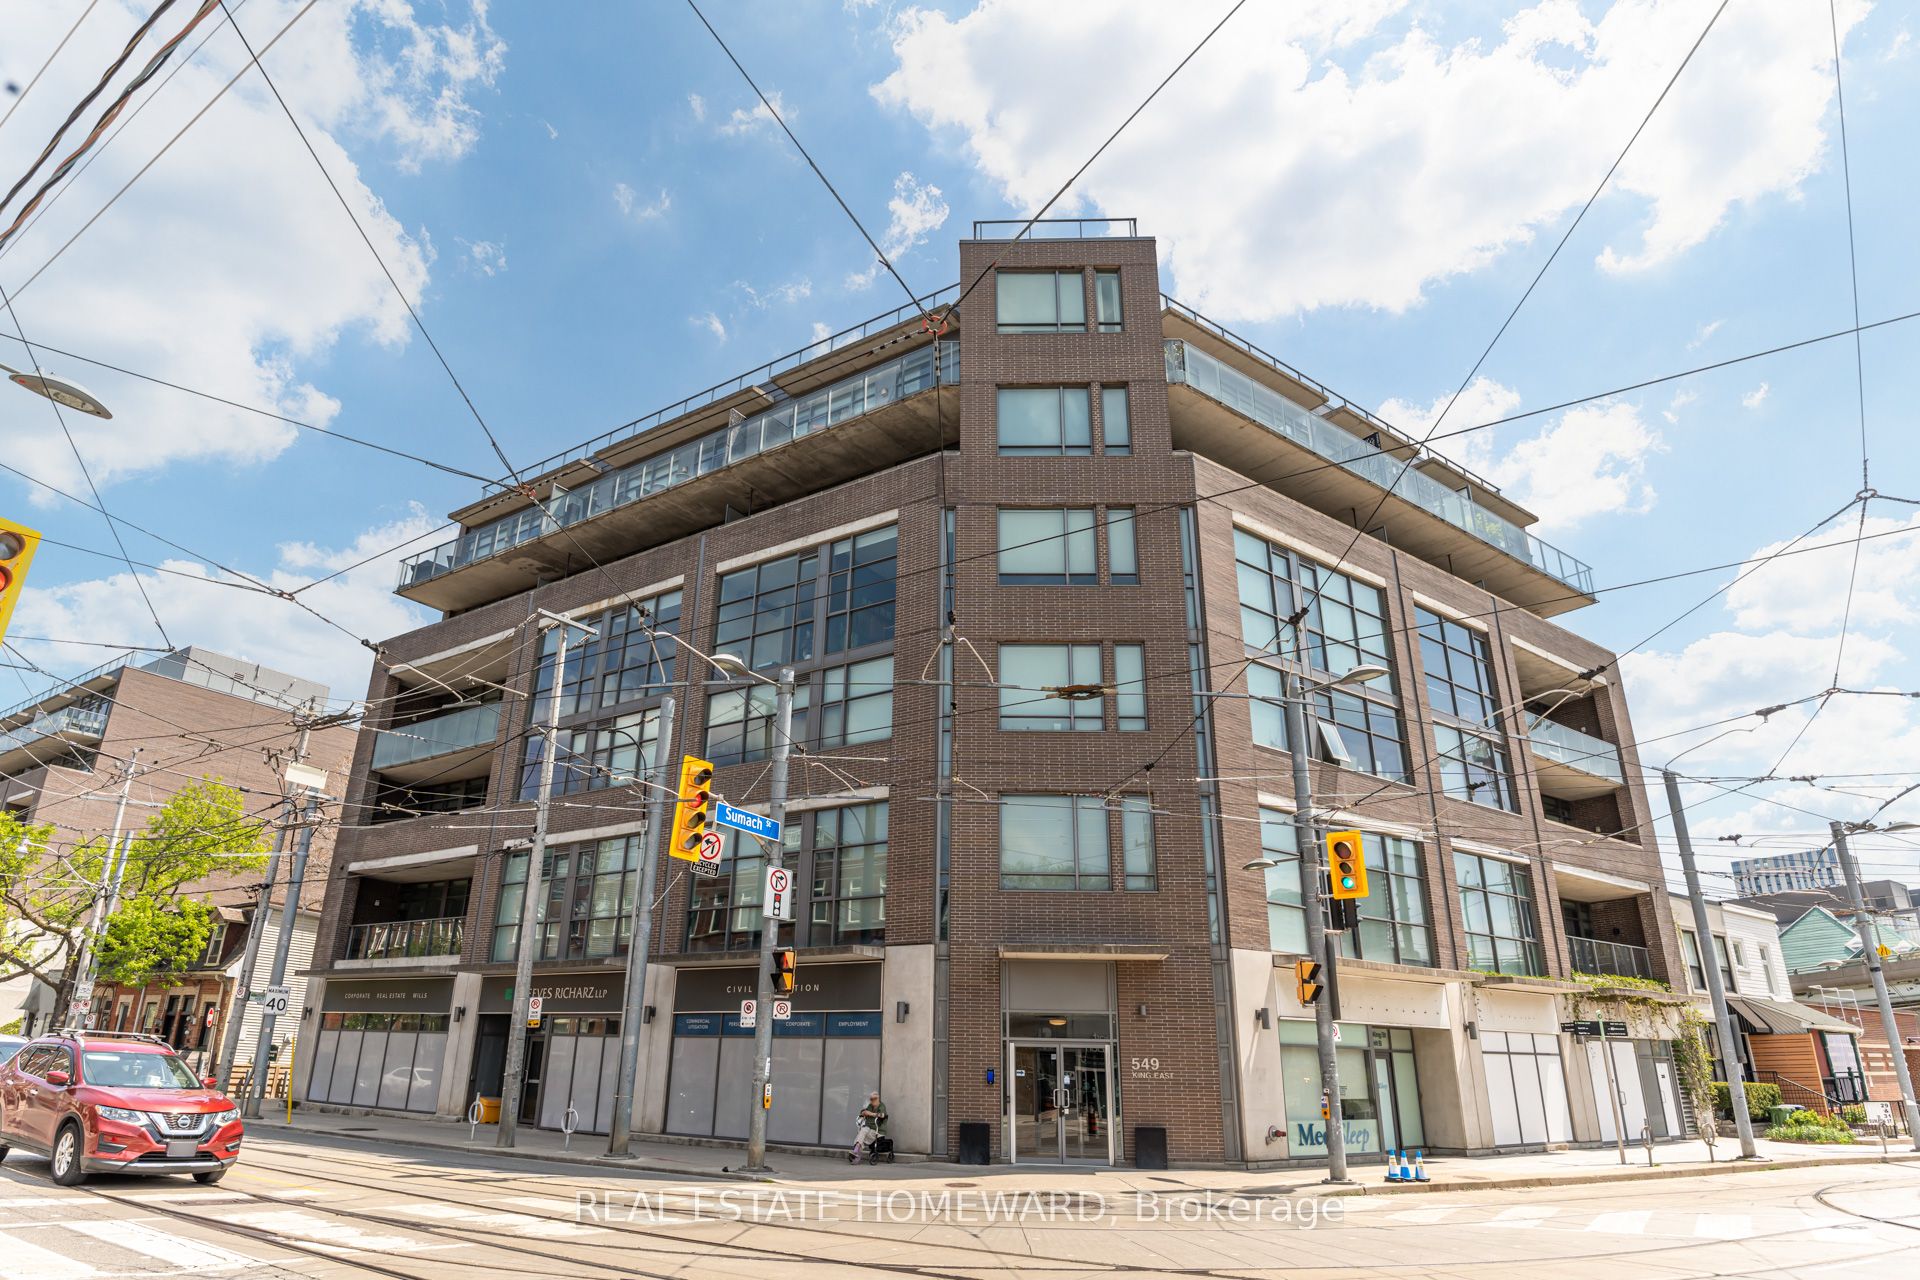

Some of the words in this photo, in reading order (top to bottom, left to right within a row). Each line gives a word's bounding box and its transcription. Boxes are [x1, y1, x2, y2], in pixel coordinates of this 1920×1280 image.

[725, 807, 763, 830] Sumach
[765, 819, 772, 828] St
[693, 864, 716, 876] EXCEPTED
[694, 861, 717, 869] CYCLES
[529, 988, 553, 999] EVES
[554, 987, 595, 999] RICHARZ
[595, 989, 608, 998] LLP
[726, 985, 753, 993] CIVIL
[266, 997, 287, 1011] 40
[1131, 1057, 1160, 1071] 549
